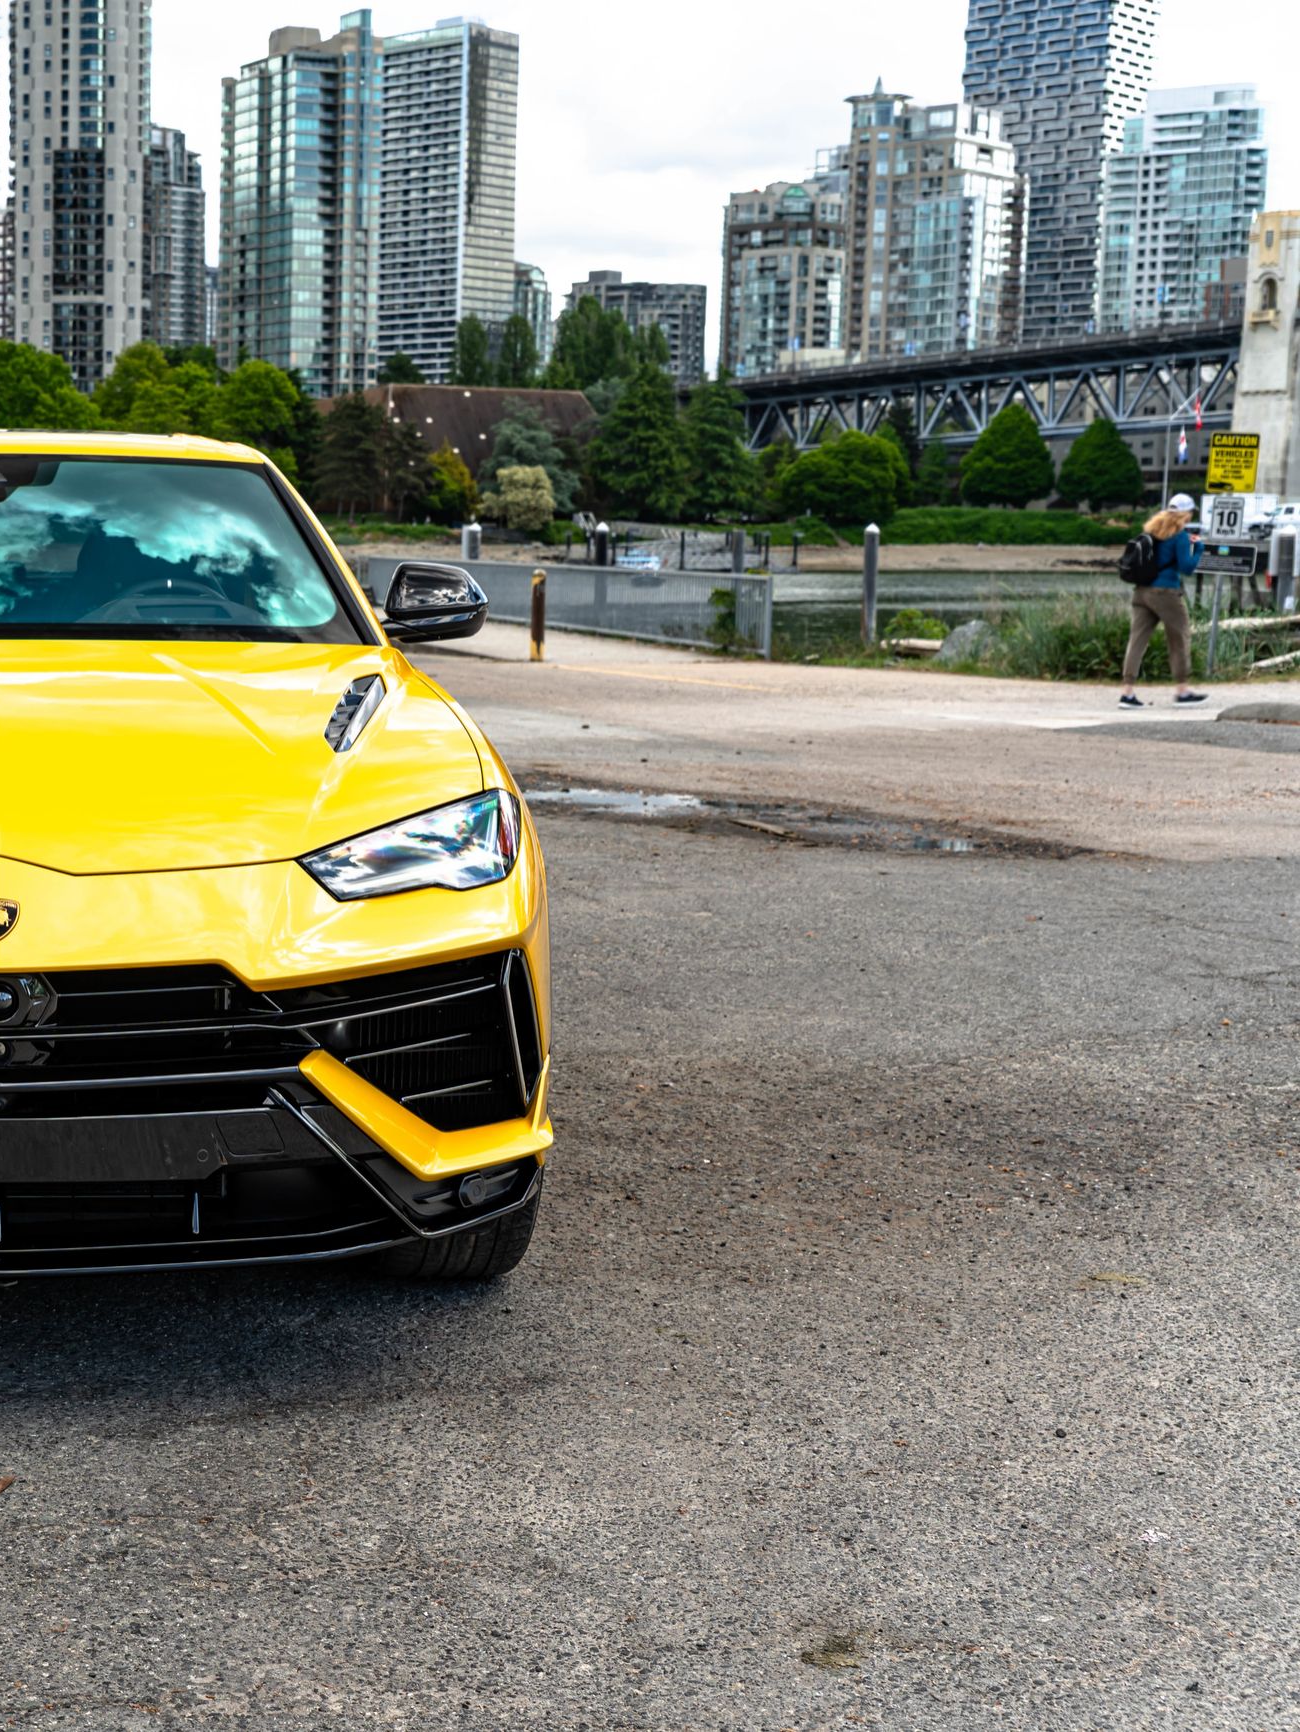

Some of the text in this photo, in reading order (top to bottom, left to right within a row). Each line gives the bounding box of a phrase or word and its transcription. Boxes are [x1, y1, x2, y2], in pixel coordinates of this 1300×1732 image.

[1214, 435, 1258, 446] CAUTION
[1215, 450, 1254, 458] VEHICLES
[1216, 510, 1238, 527] 10
